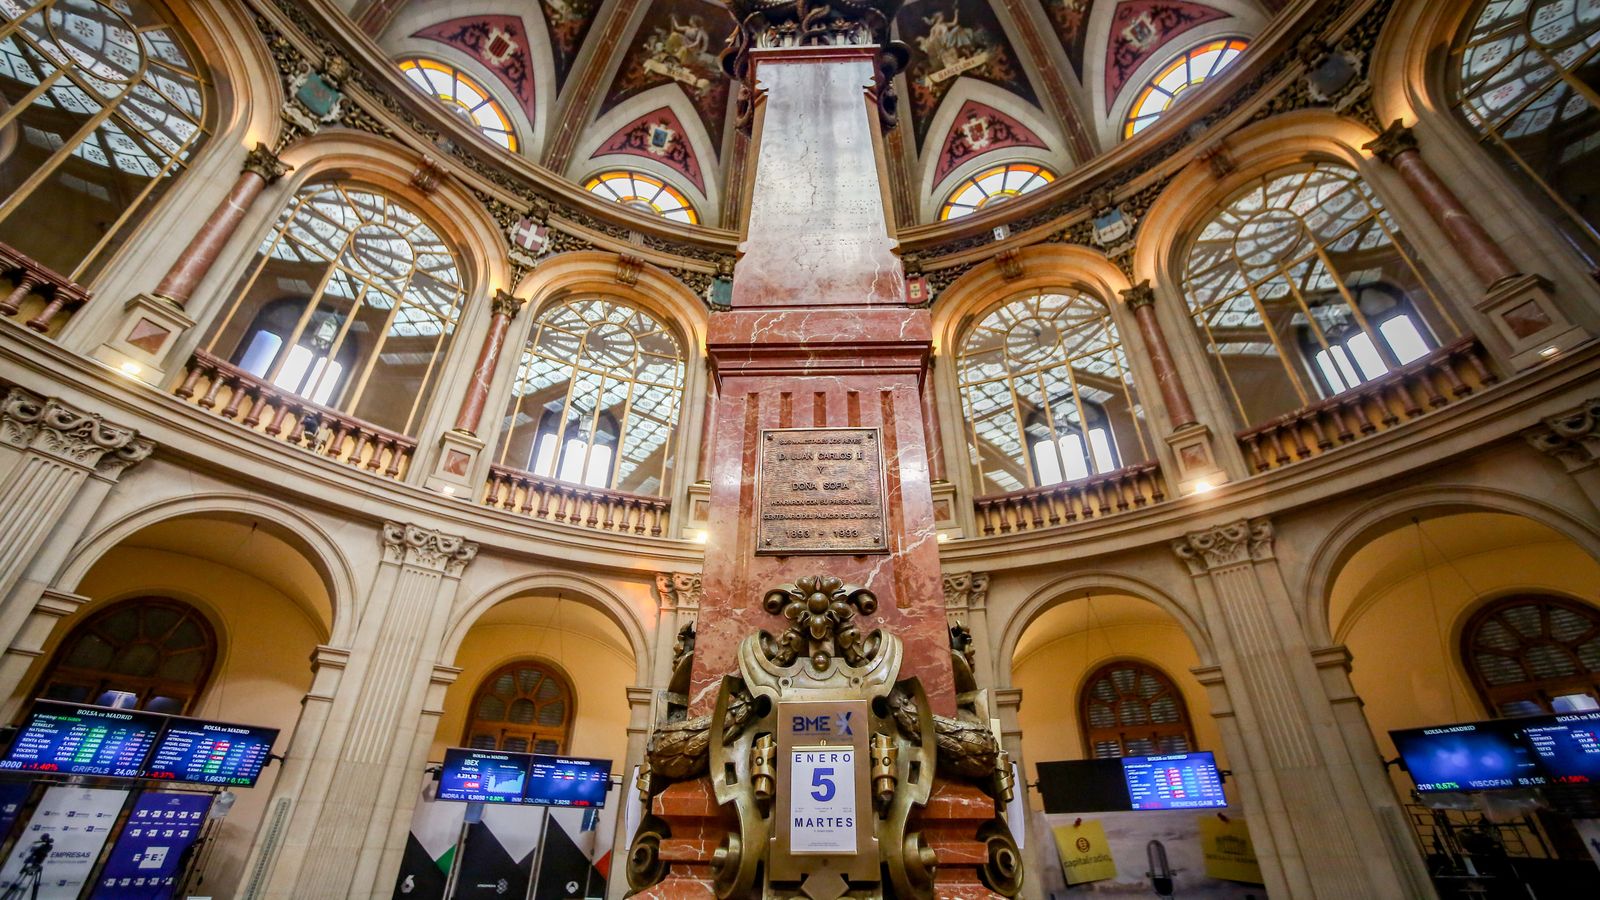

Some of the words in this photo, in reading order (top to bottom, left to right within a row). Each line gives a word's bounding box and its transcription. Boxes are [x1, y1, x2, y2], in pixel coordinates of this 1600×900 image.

[818, 452, 852, 460] CARLOS
[857, 452, 863, 460] I
[817, 466, 824, 474] Y
[792, 716, 830, 732] BME
[795, 754, 851, 763] ENERO
[72, 766, 110, 774] GRIFOLS
[810, 768, 836, 802] 5
[1469, 779, 1513, 788] VISCOFAN
[794, 818, 853, 828] MARTES
